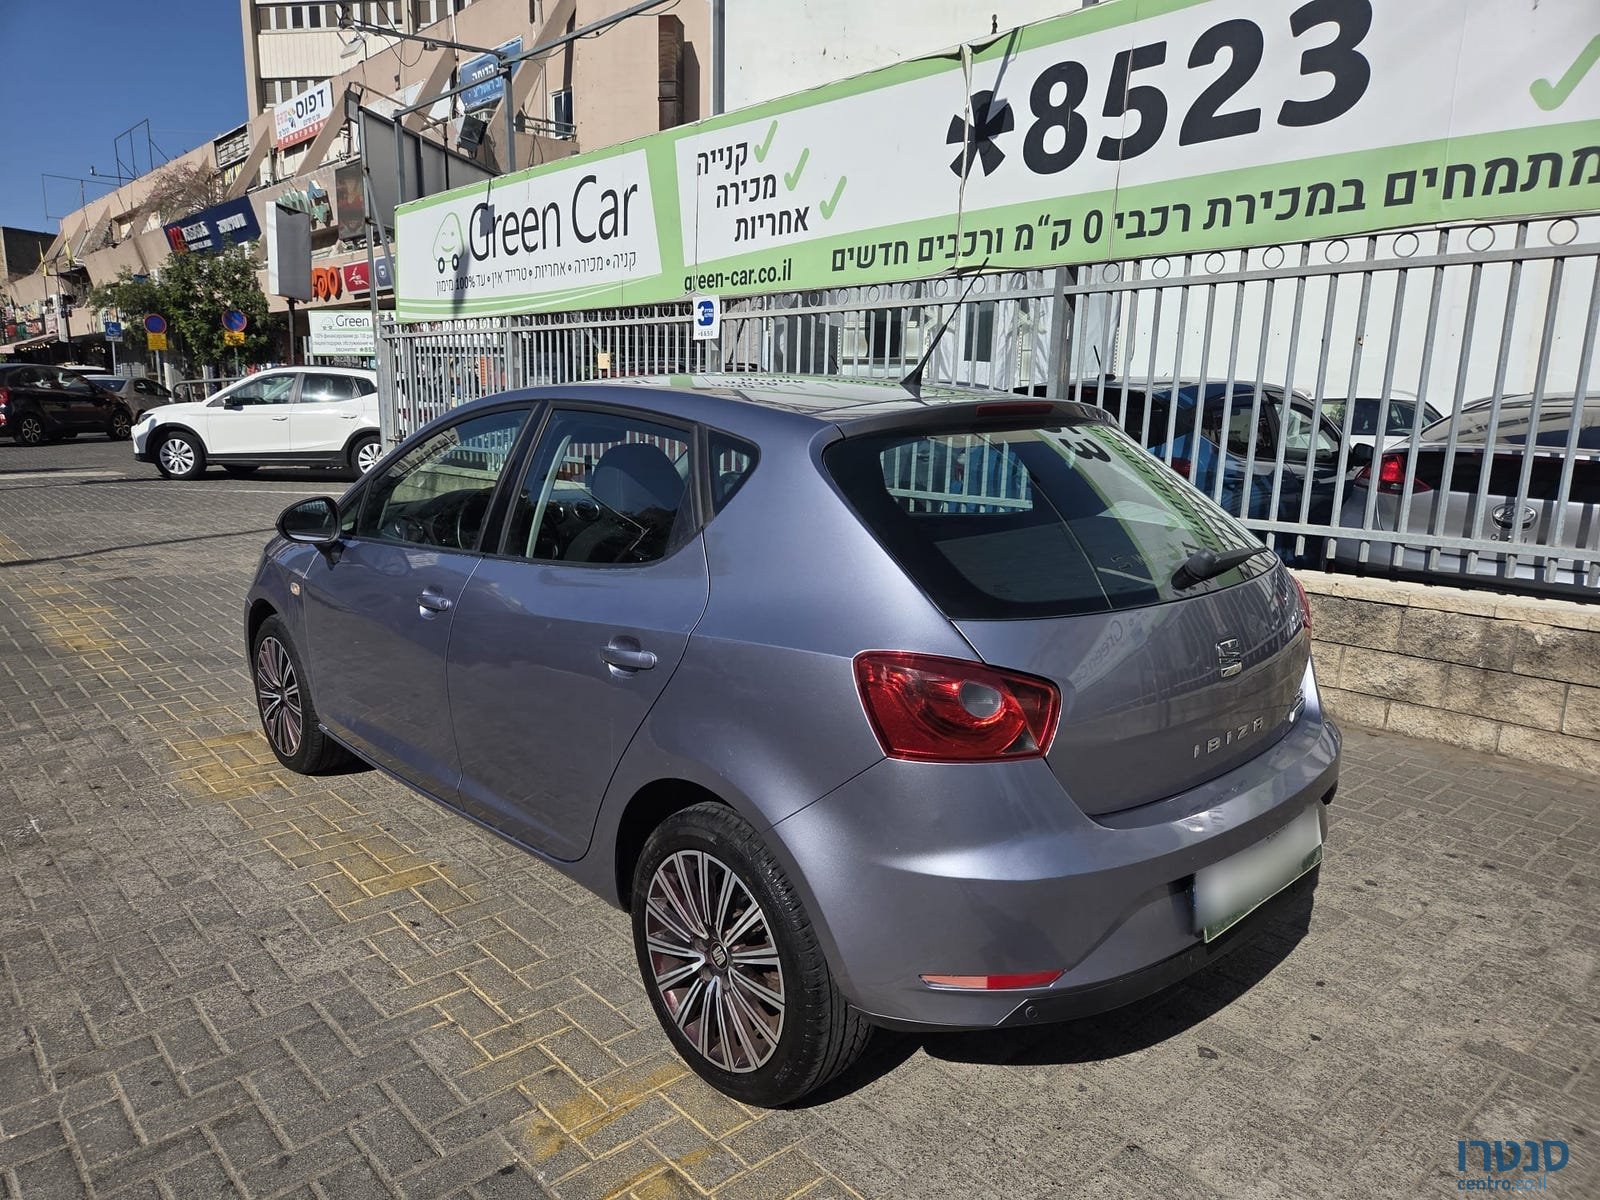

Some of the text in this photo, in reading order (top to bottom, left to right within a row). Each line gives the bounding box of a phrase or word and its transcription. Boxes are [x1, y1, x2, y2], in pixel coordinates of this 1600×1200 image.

[295, 89, 324, 119] דפוס
[697, 142, 748, 176] קנייה
[716, 173, 777, 208] מכירה
[1384, 146, 1600, 208] מתמחים
[469, 175, 638, 261] Green Car
[1203, 178, 1366, 230] במכירת
[734, 206, 810, 242] אחריות
[1083, 209, 1103, 244] 0
[1114, 203, 1191, 240] רכבי
[612, 251, 637, 271] קניה
[831, 240, 909, 272] חדשים
[918, 227, 1003, 262] ורכבים
[455, 275, 475, 290] 100%
[476, 273, 486, 288] עד
[492, 270, 503, 288] אין
[505, 266, 528, 283] טרייד
[534, 261, 566, 280] אחריות
[574, 256, 604, 275] מכירה
[684, 258, 792, 294] green-car.co.il
[335, 314, 369, 327] Green
[1193, 716, 1264, 759] IBIZA
